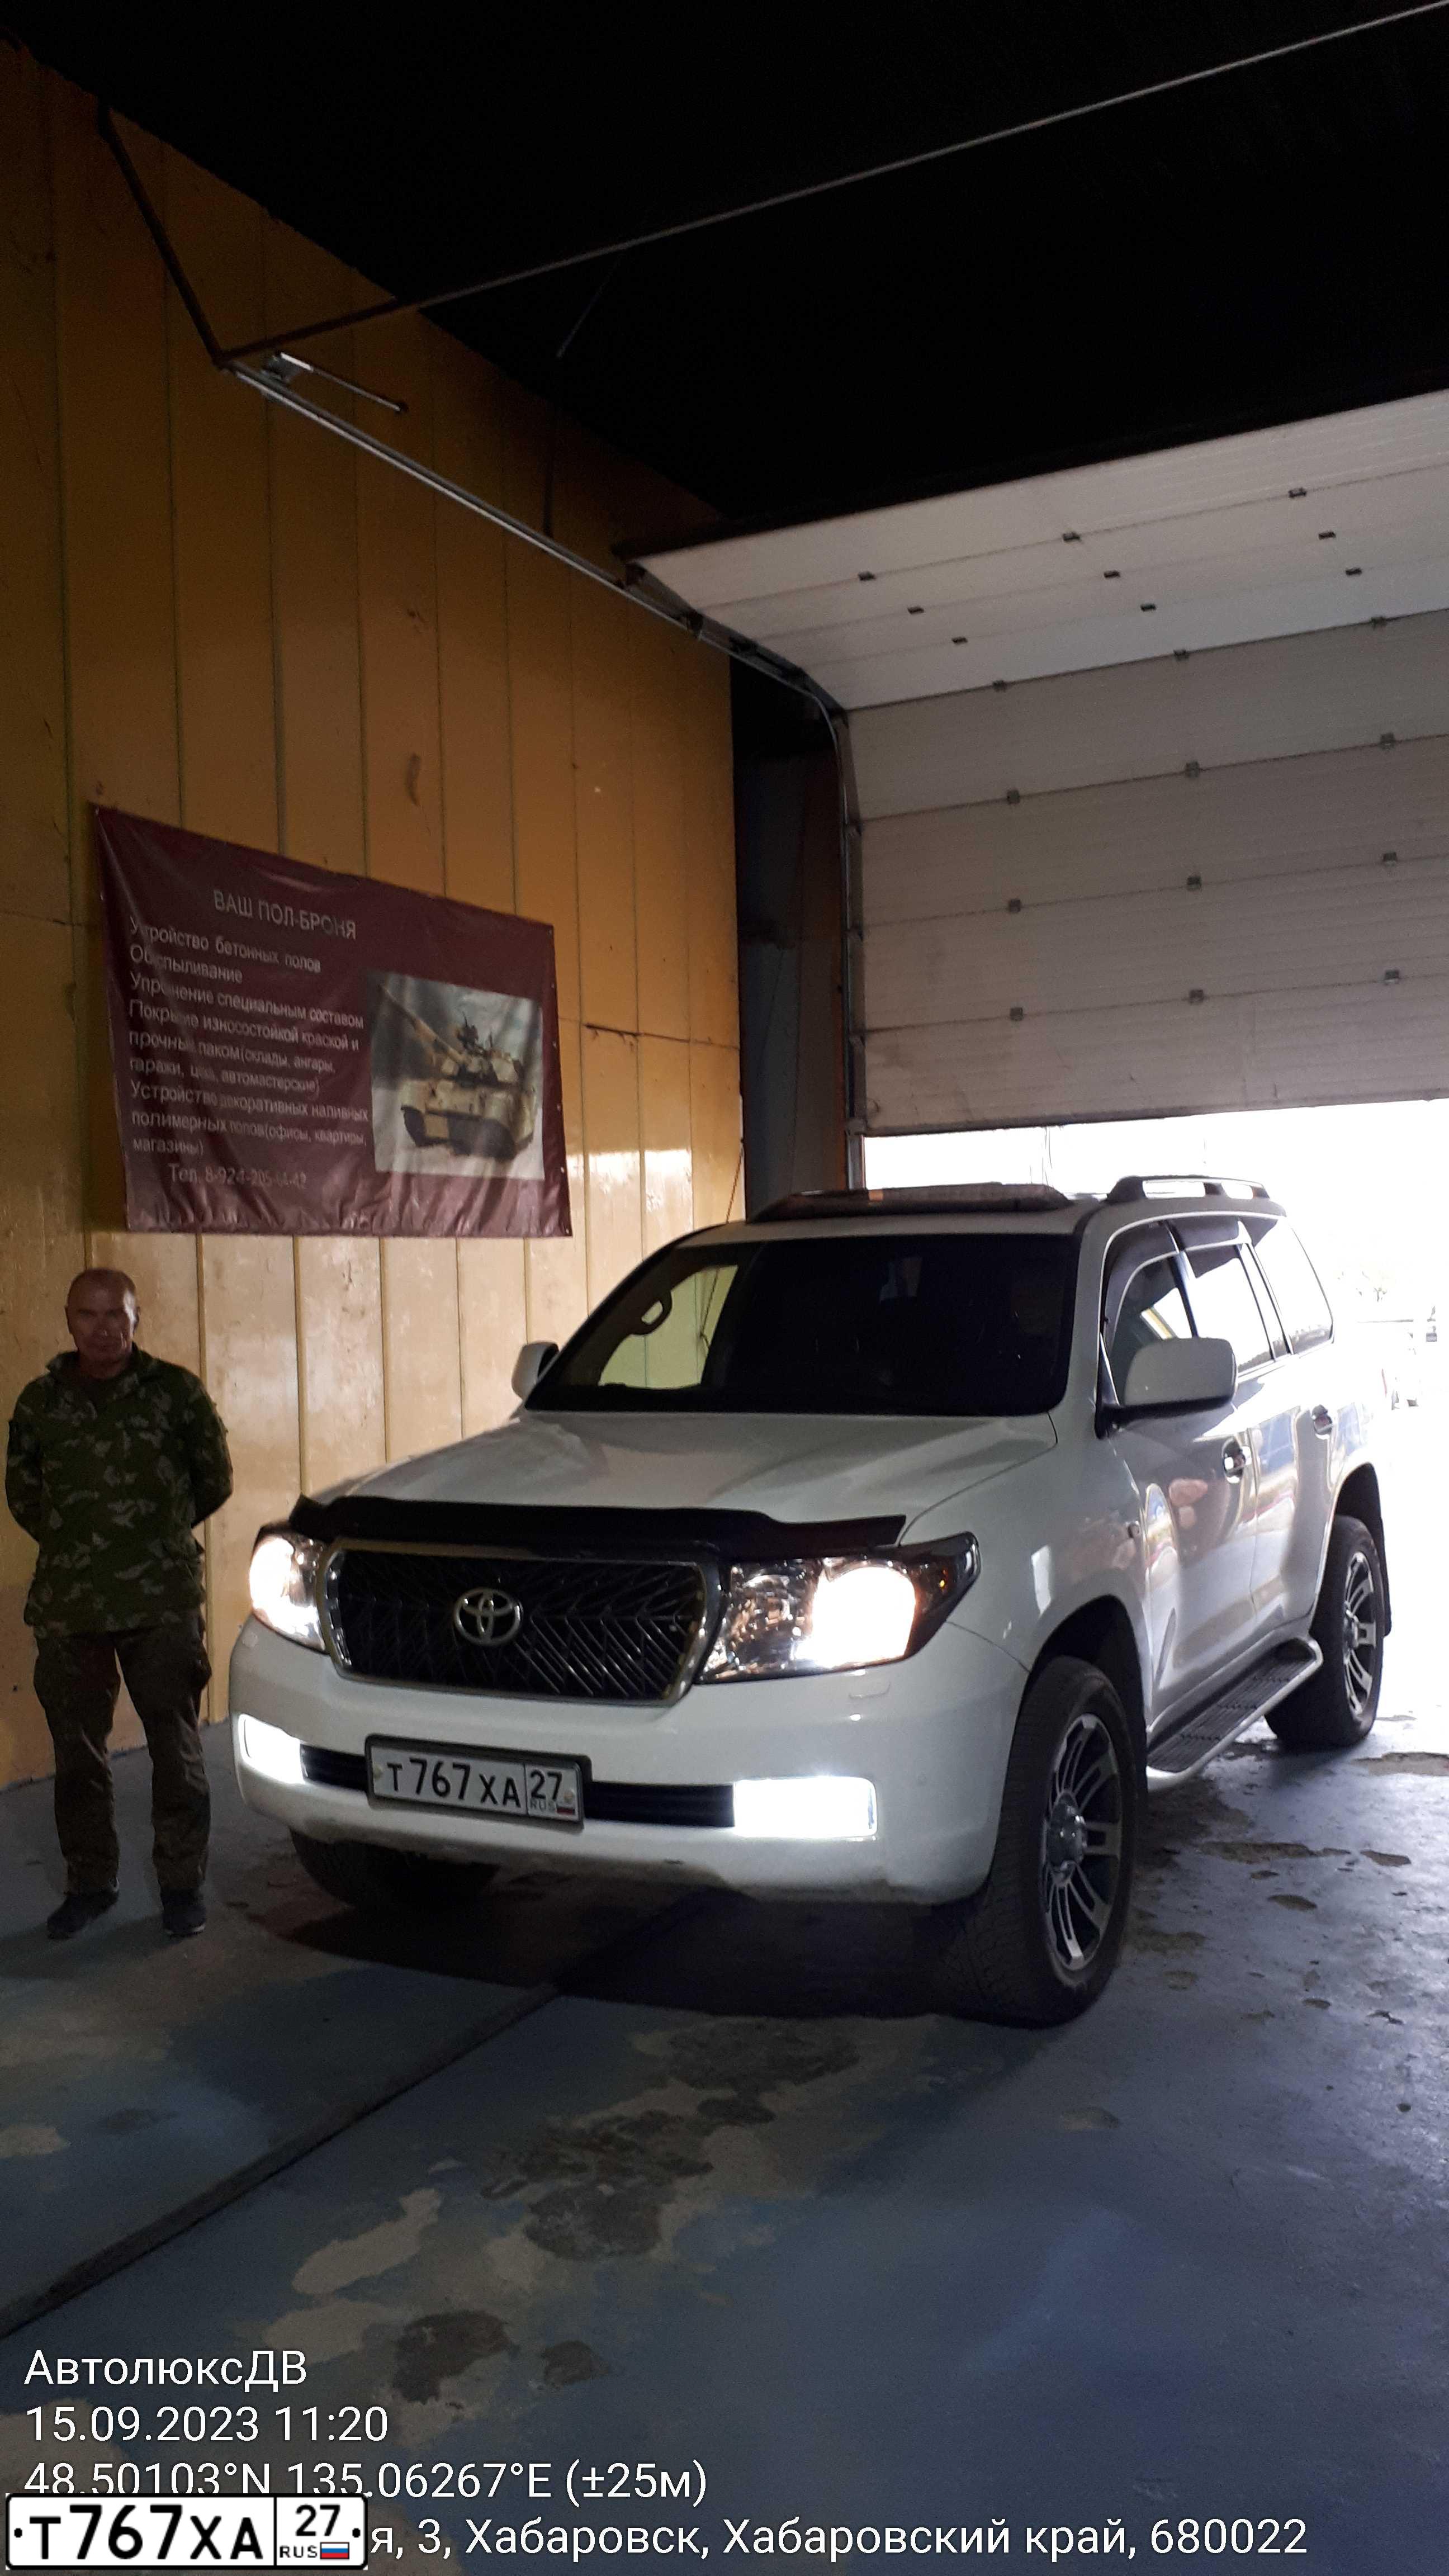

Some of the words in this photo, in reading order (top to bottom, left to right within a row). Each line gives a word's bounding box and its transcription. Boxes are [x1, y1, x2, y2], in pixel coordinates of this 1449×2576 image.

[214, 889, 253, 917] ВАШ
[258, 899, 356, 940] ПОЛ-БРОНЯ
[215, 935, 280, 964] бетонных
[285, 953, 321, 973] полов
[217, 992, 307, 1019] специальным
[309, 1007, 364, 1029] составом
[302, 1032, 349, 1050] краской
[351, 1039, 359, 1052] и
[131, 1078, 219, 1106] Устройство
[131, 1111, 227, 1134] полимерных
[529, 1769, 562, 1801] 27
